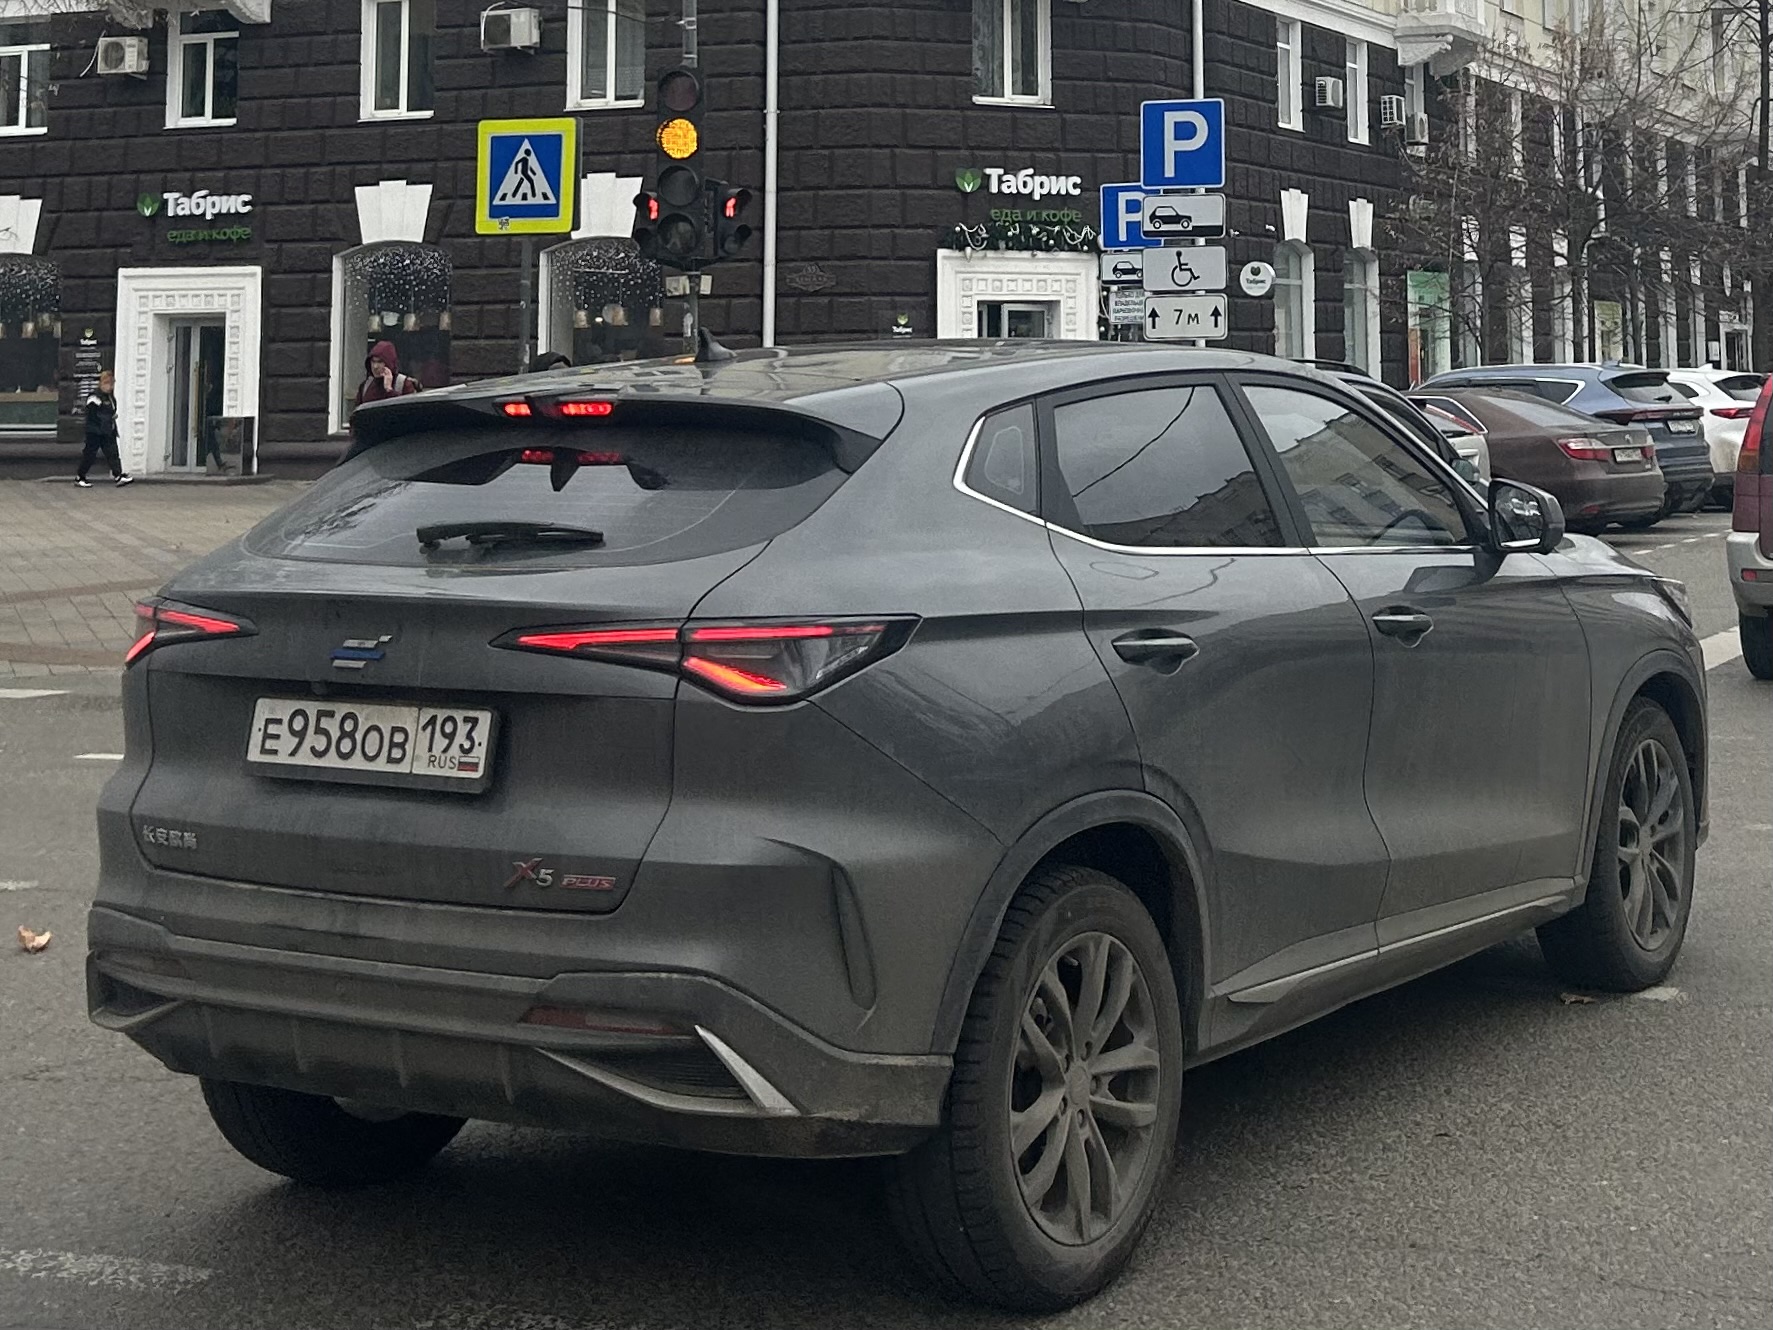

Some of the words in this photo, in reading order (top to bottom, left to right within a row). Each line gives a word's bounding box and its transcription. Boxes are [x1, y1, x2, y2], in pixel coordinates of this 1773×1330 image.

[1164, 111, 1209, 178] P
[983, 167, 1082, 200] Табрис
[163, 189, 253, 220] Табрис
[990, 208, 1022, 224] еда
[1026, 209, 1037, 220] и
[1040, 206, 1082, 224] кофе
[211, 225, 252, 242] кофе
[1173, 308, 1184, 325] 7
[421, 714, 480, 755] 193
[427, 753, 458, 770] RUS
[503, 857, 555, 888] X5
[560, 876, 615, 889] PLUS
